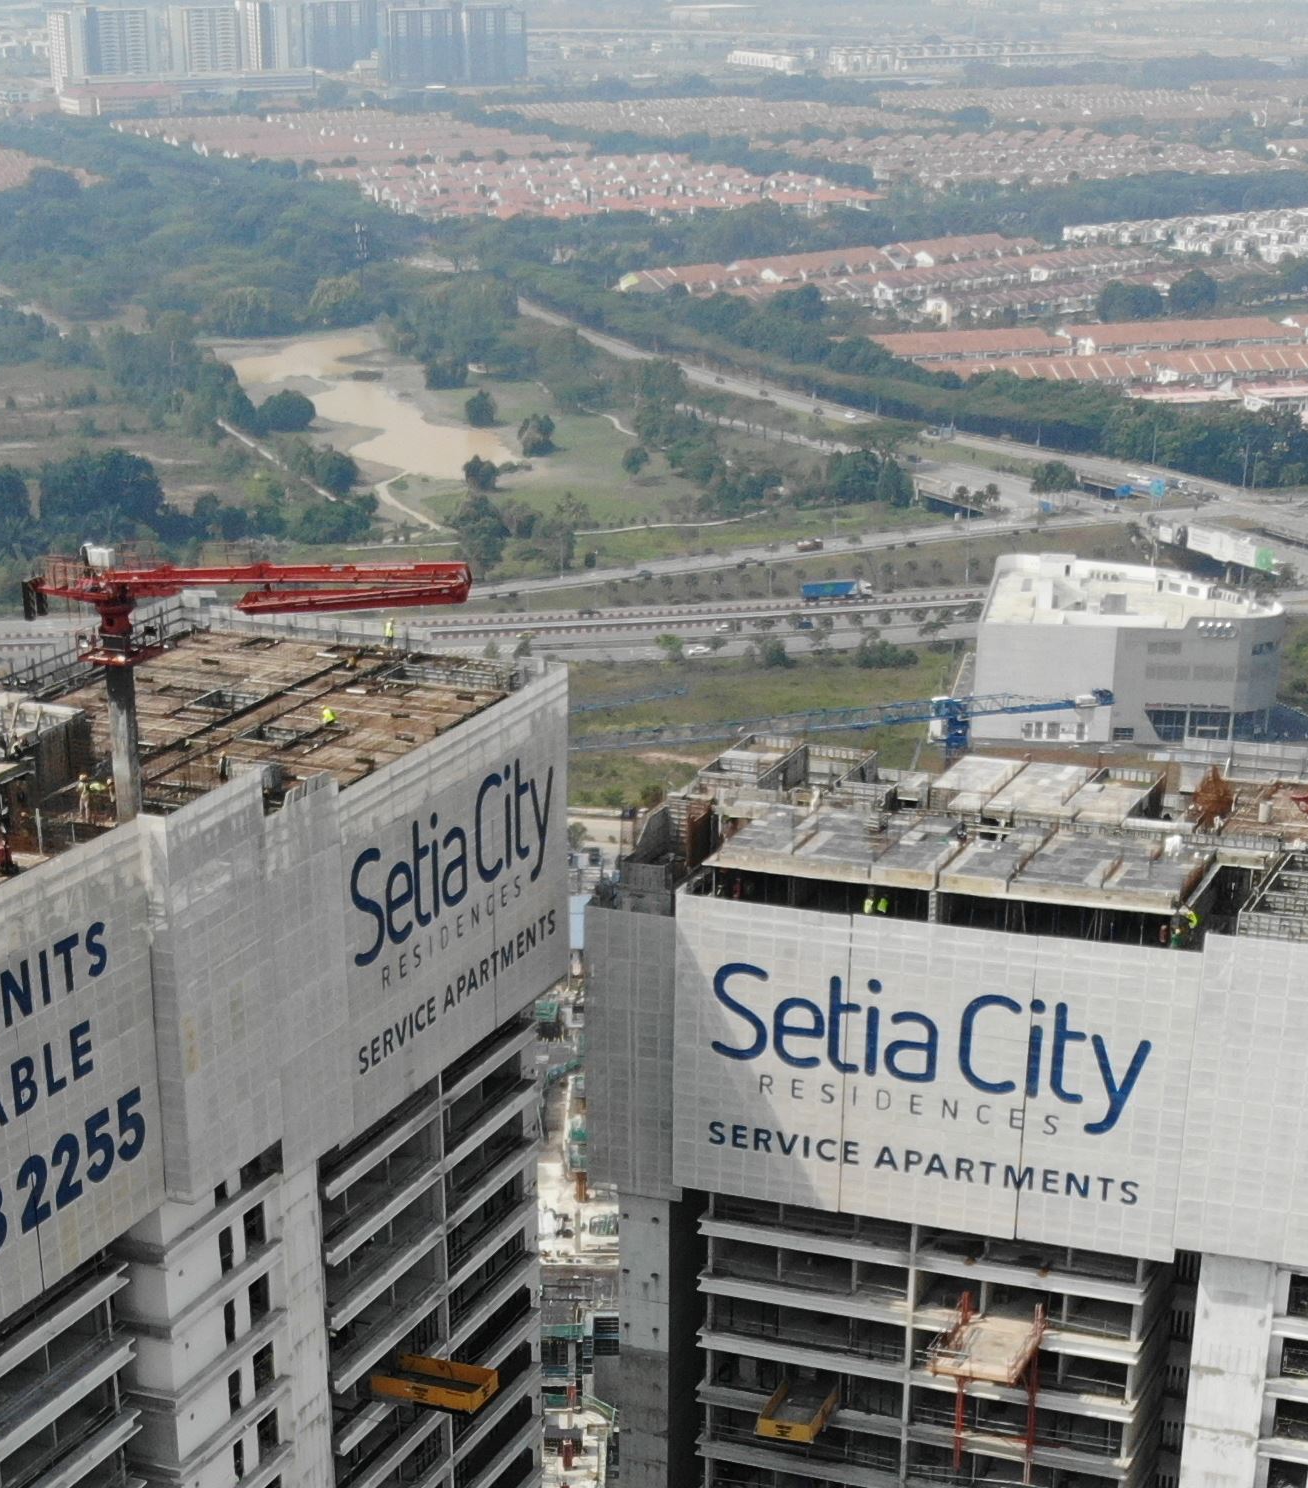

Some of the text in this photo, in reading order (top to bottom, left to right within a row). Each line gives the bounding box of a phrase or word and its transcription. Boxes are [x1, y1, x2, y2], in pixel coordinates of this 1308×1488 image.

[350, 758, 553, 967] Setia City
[382, 875, 521, 990] RESIDENCES
[359, 909, 556, 1075] SERVICE APARTMENTS
[712, 962, 1152, 1135] Setia City
[16, 1086, 146, 1234] 2255
[708, 1121, 1141, 1205] SERVICE APARTMENTS
[758, 1075, 1061, 1136] RESIDENCES
